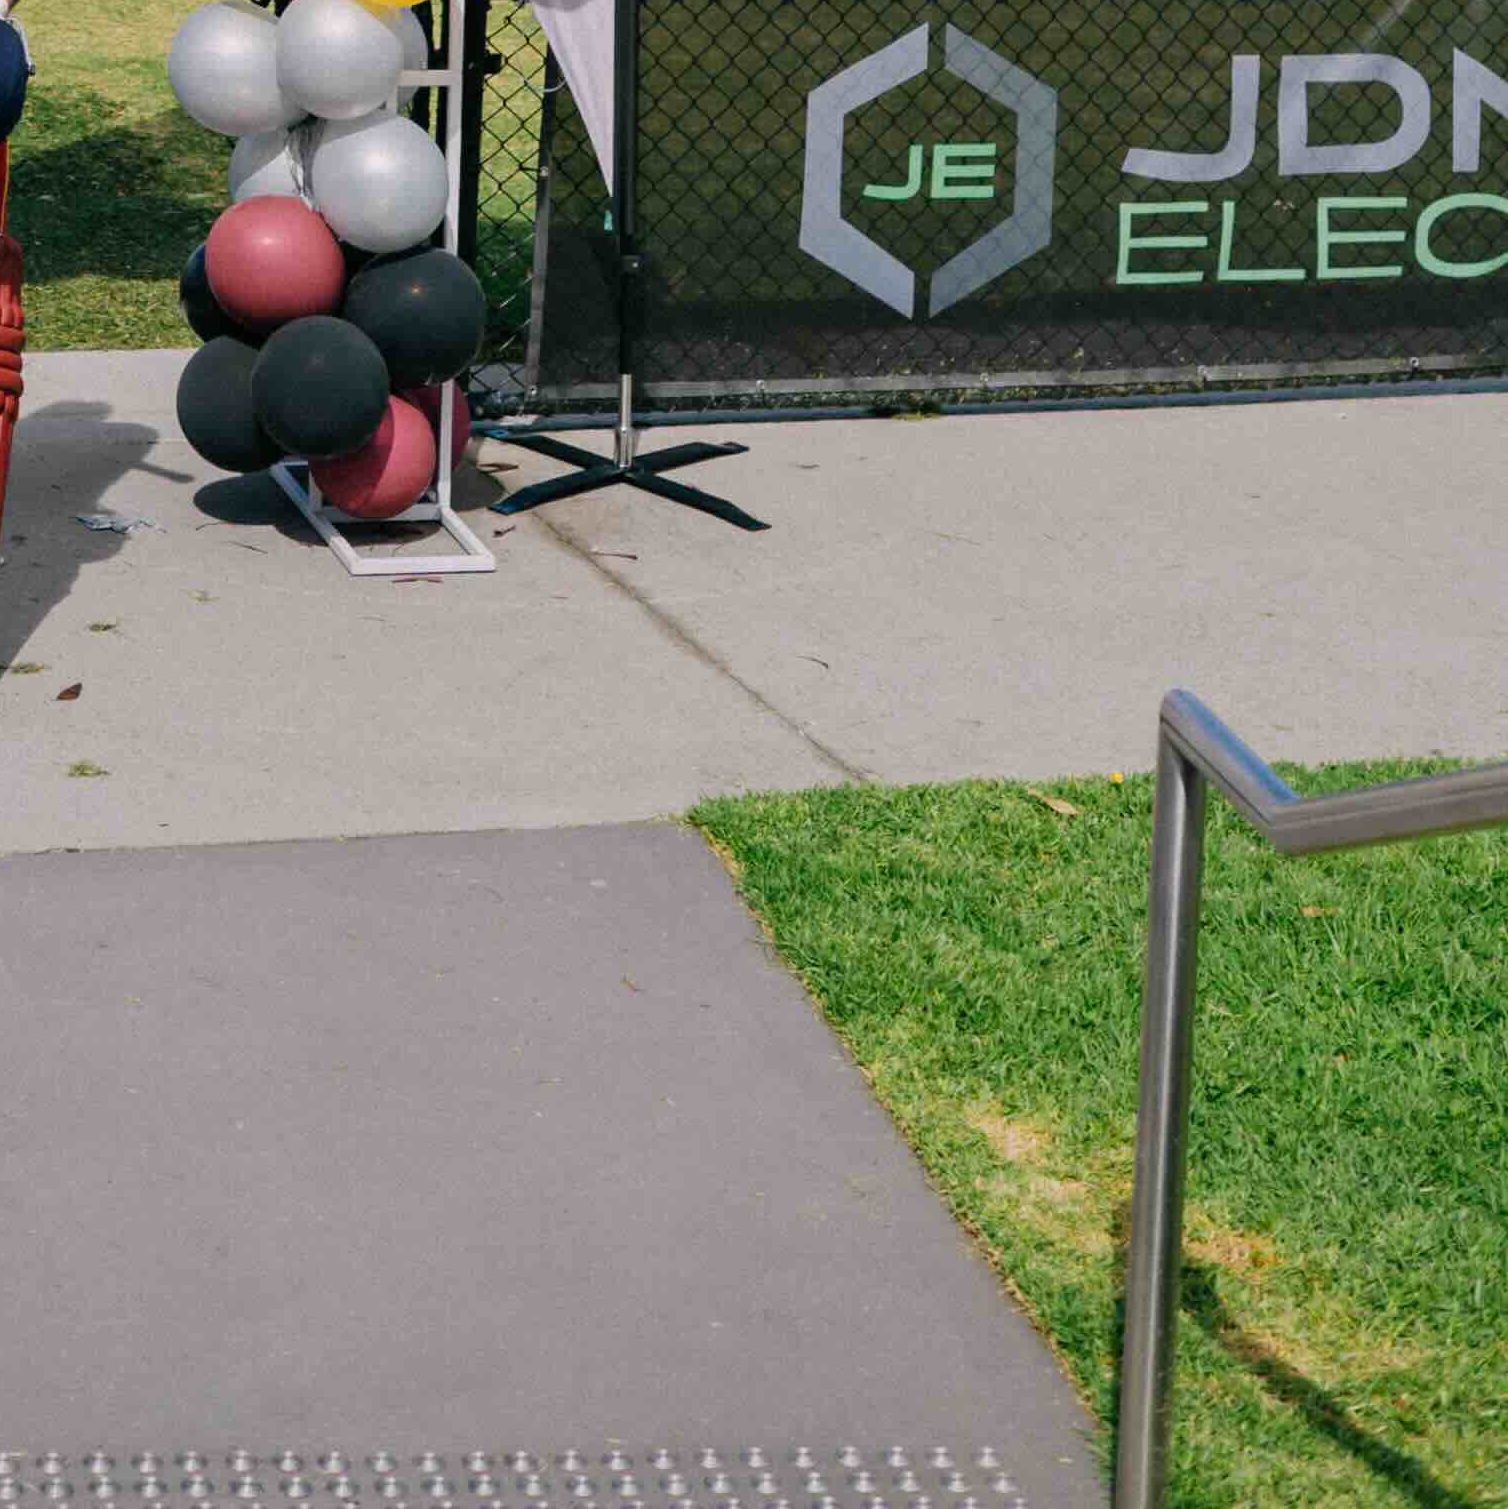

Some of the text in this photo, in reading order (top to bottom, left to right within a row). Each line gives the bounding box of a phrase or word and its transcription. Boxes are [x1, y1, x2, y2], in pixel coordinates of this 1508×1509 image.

[1120, 46, 1508, 182] JD
[862, 142, 997, 200] JE
[1115, 193, 1508, 285] ELEC
